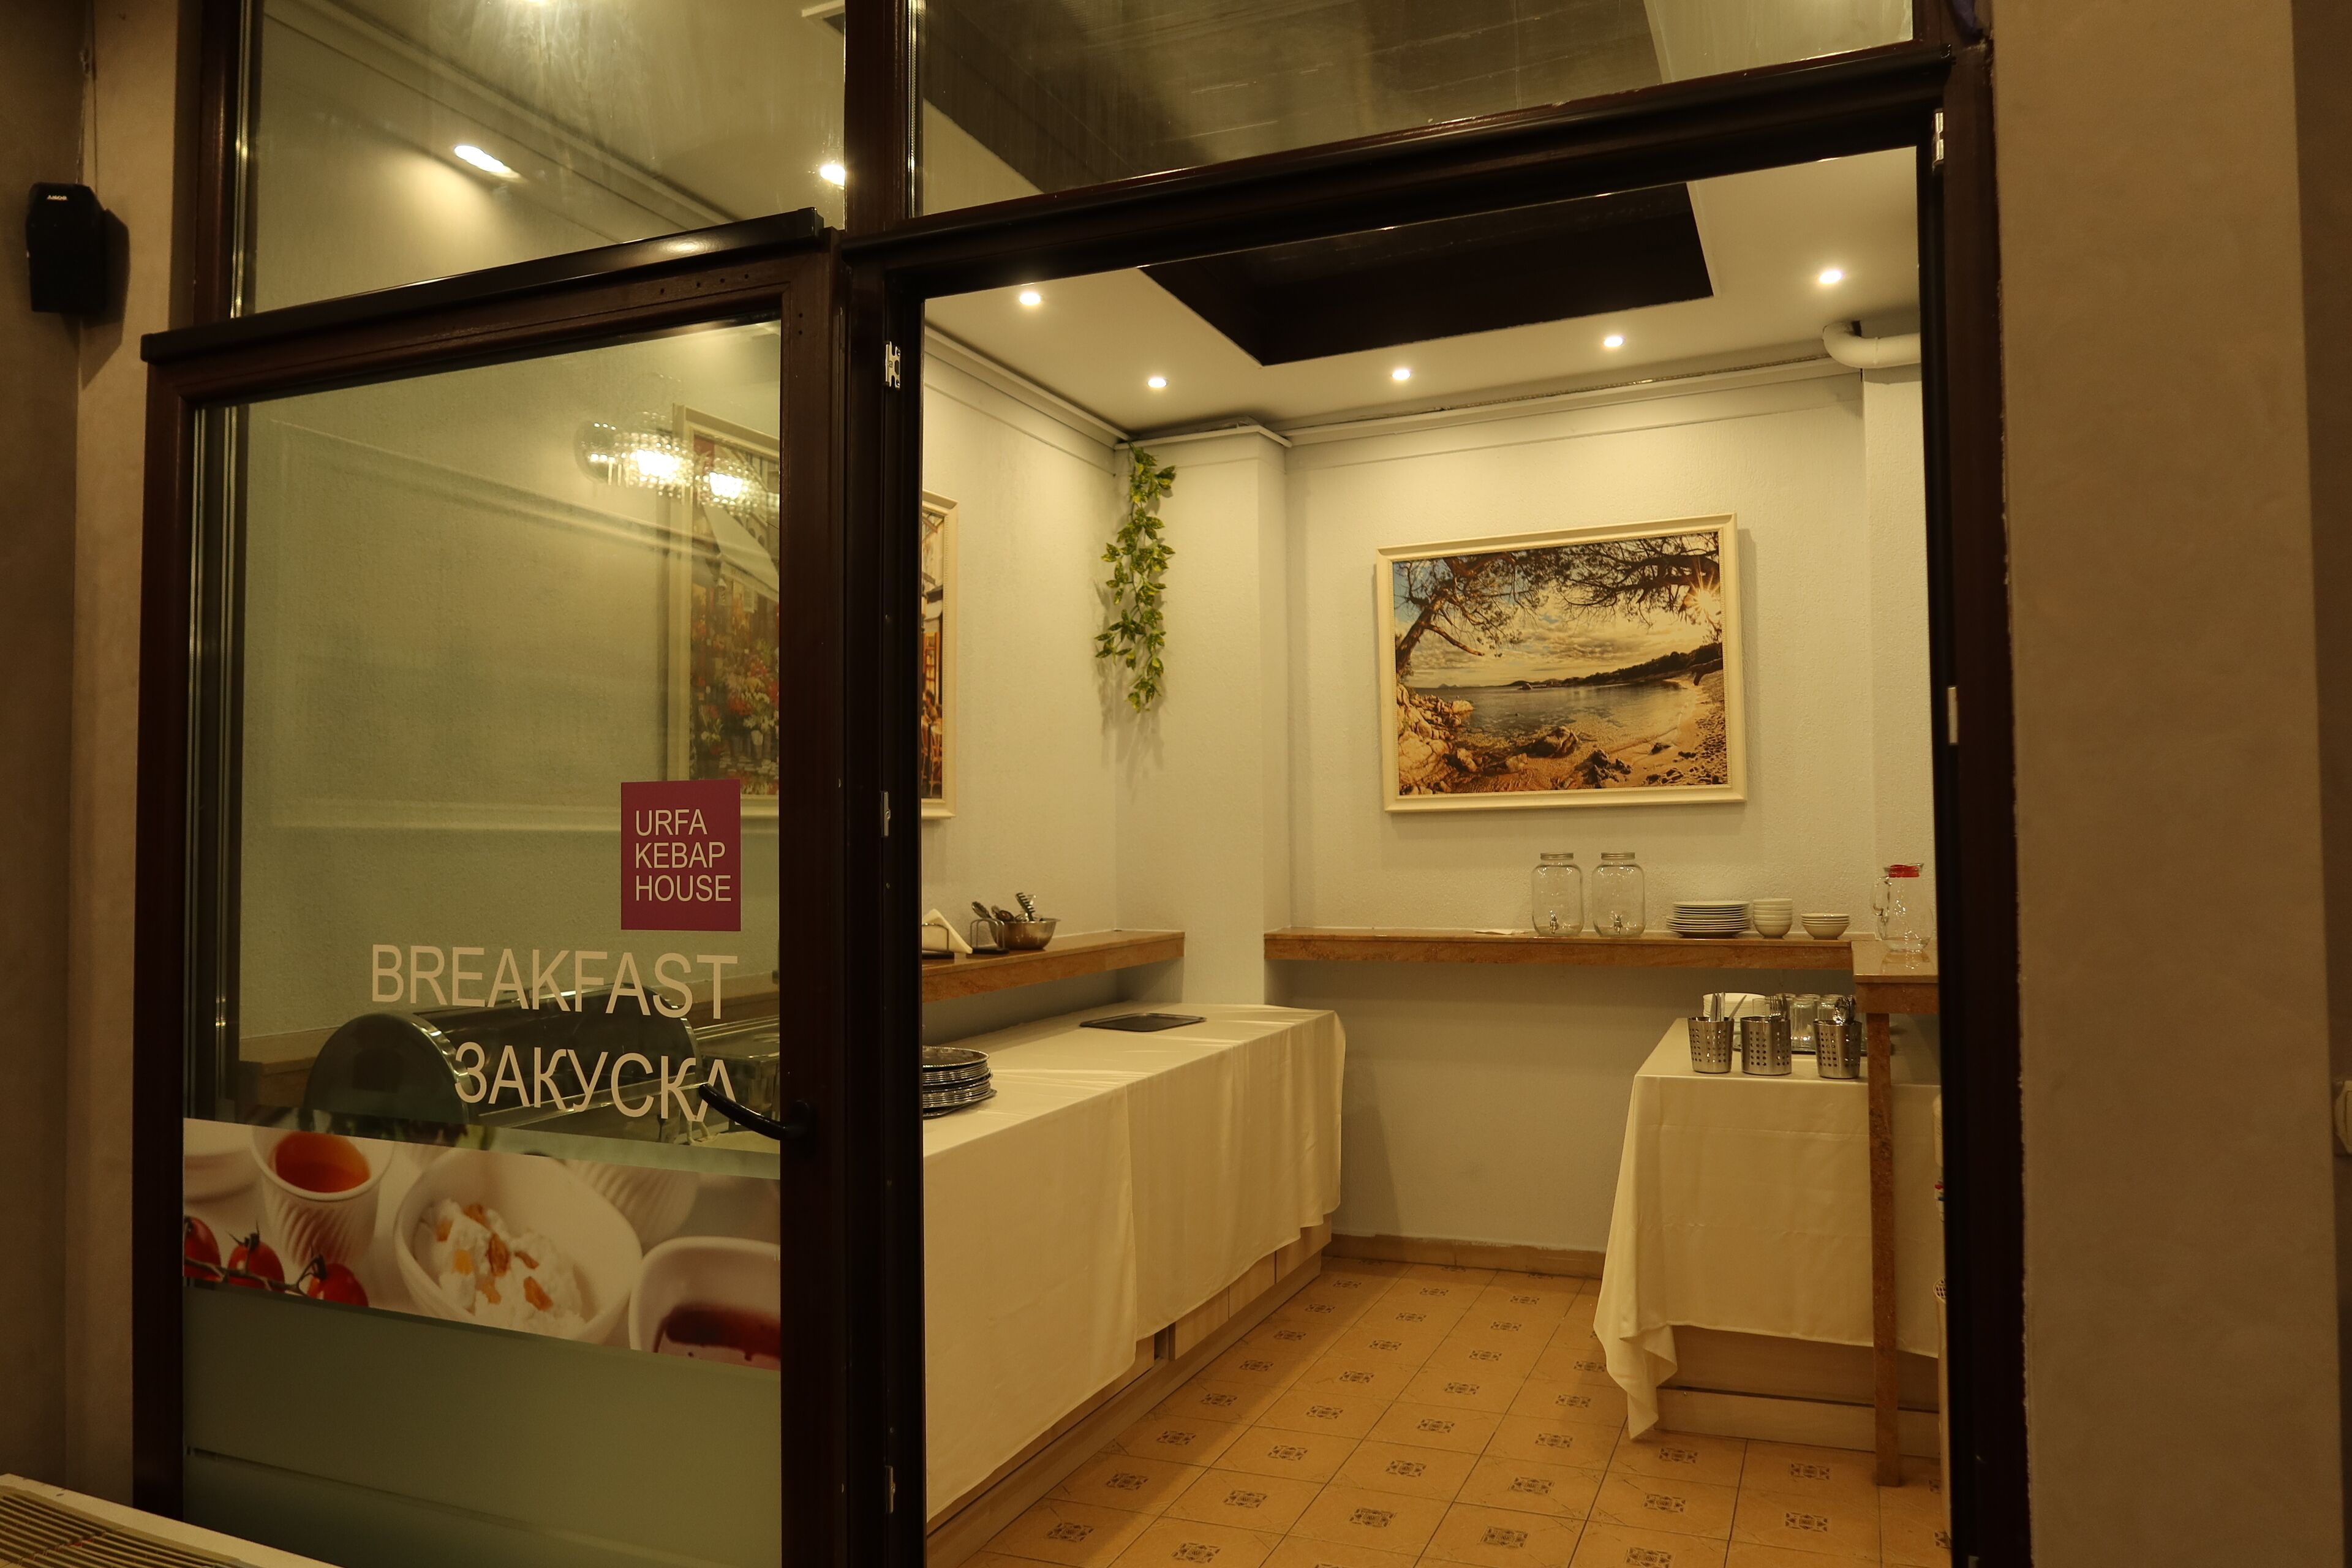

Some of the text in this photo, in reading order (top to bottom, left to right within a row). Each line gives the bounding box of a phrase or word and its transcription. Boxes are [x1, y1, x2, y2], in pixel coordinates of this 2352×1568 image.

[636, 809, 708, 836] URFA
[635, 842, 726, 869] KEBAP
[636, 875, 731, 902] HOUSE
[372, 944, 738, 1020] BREAKFAST
